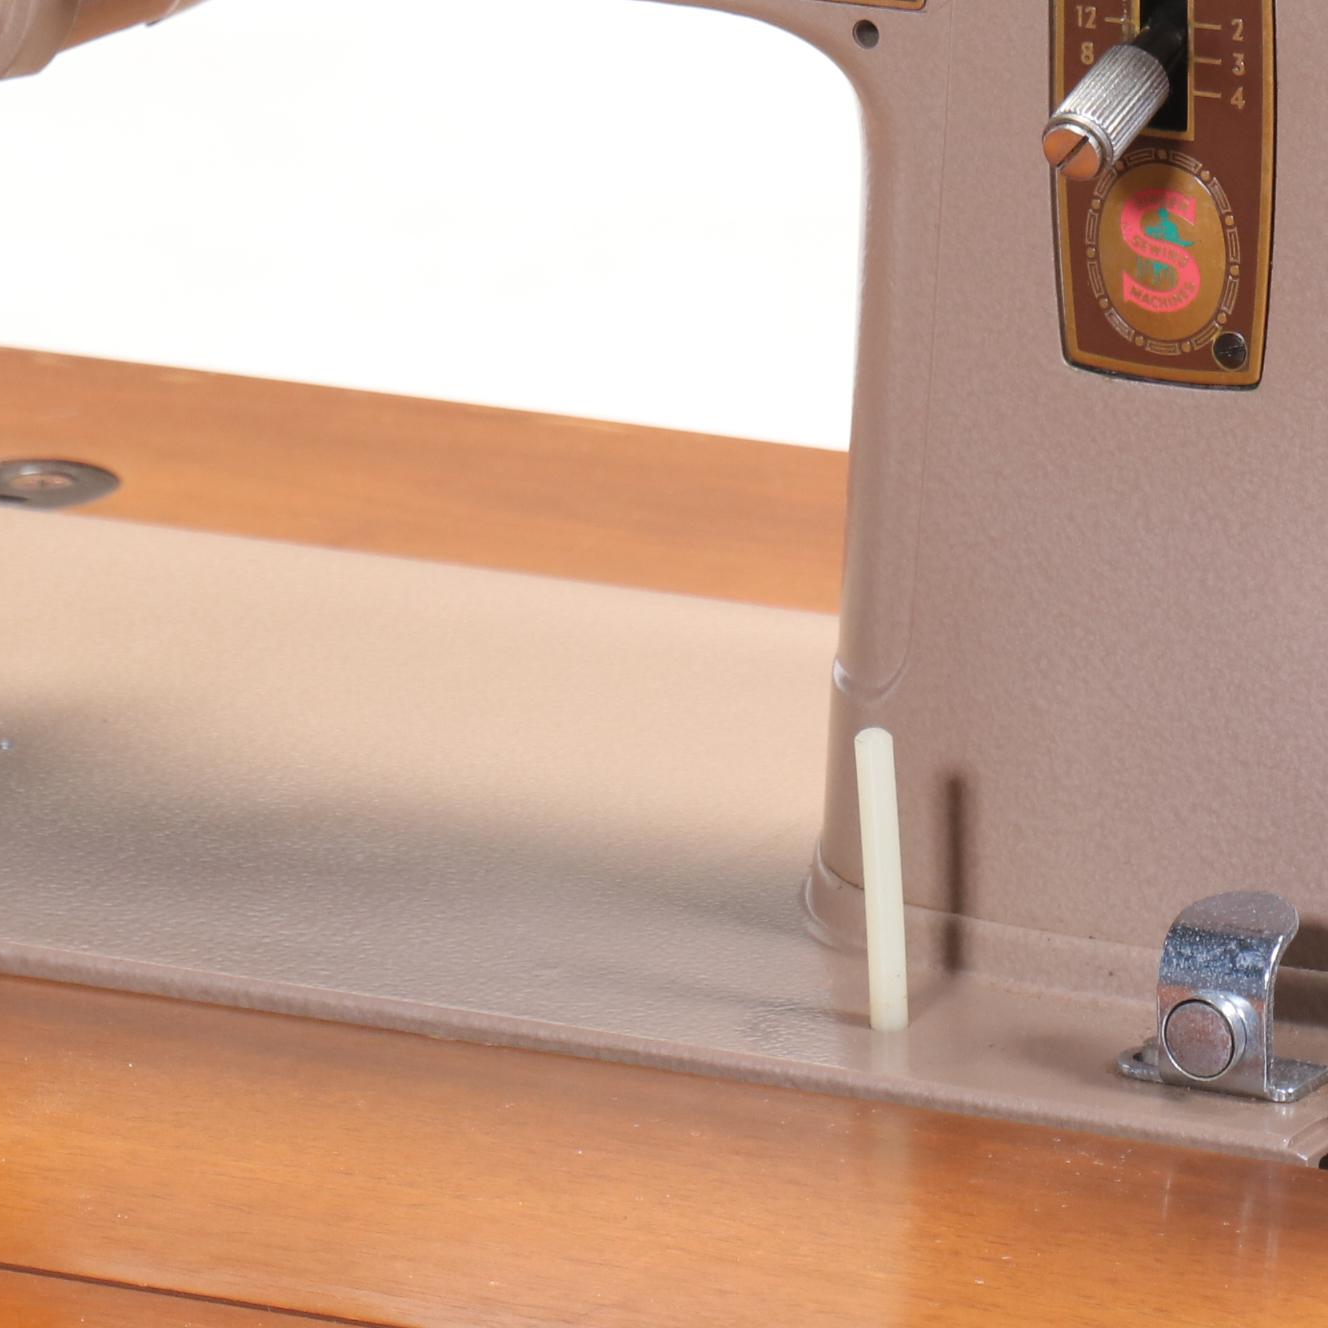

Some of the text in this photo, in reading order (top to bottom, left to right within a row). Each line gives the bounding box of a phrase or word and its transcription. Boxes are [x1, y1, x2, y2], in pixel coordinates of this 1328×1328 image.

[1076, 6, 1097, 29] 12
[1232, 19, 1244, 42] 2
[1081, 42, 1094, 65] 8
[1232, 54, 1245, 77] 3
[1230, 86, 1245, 109] 4
